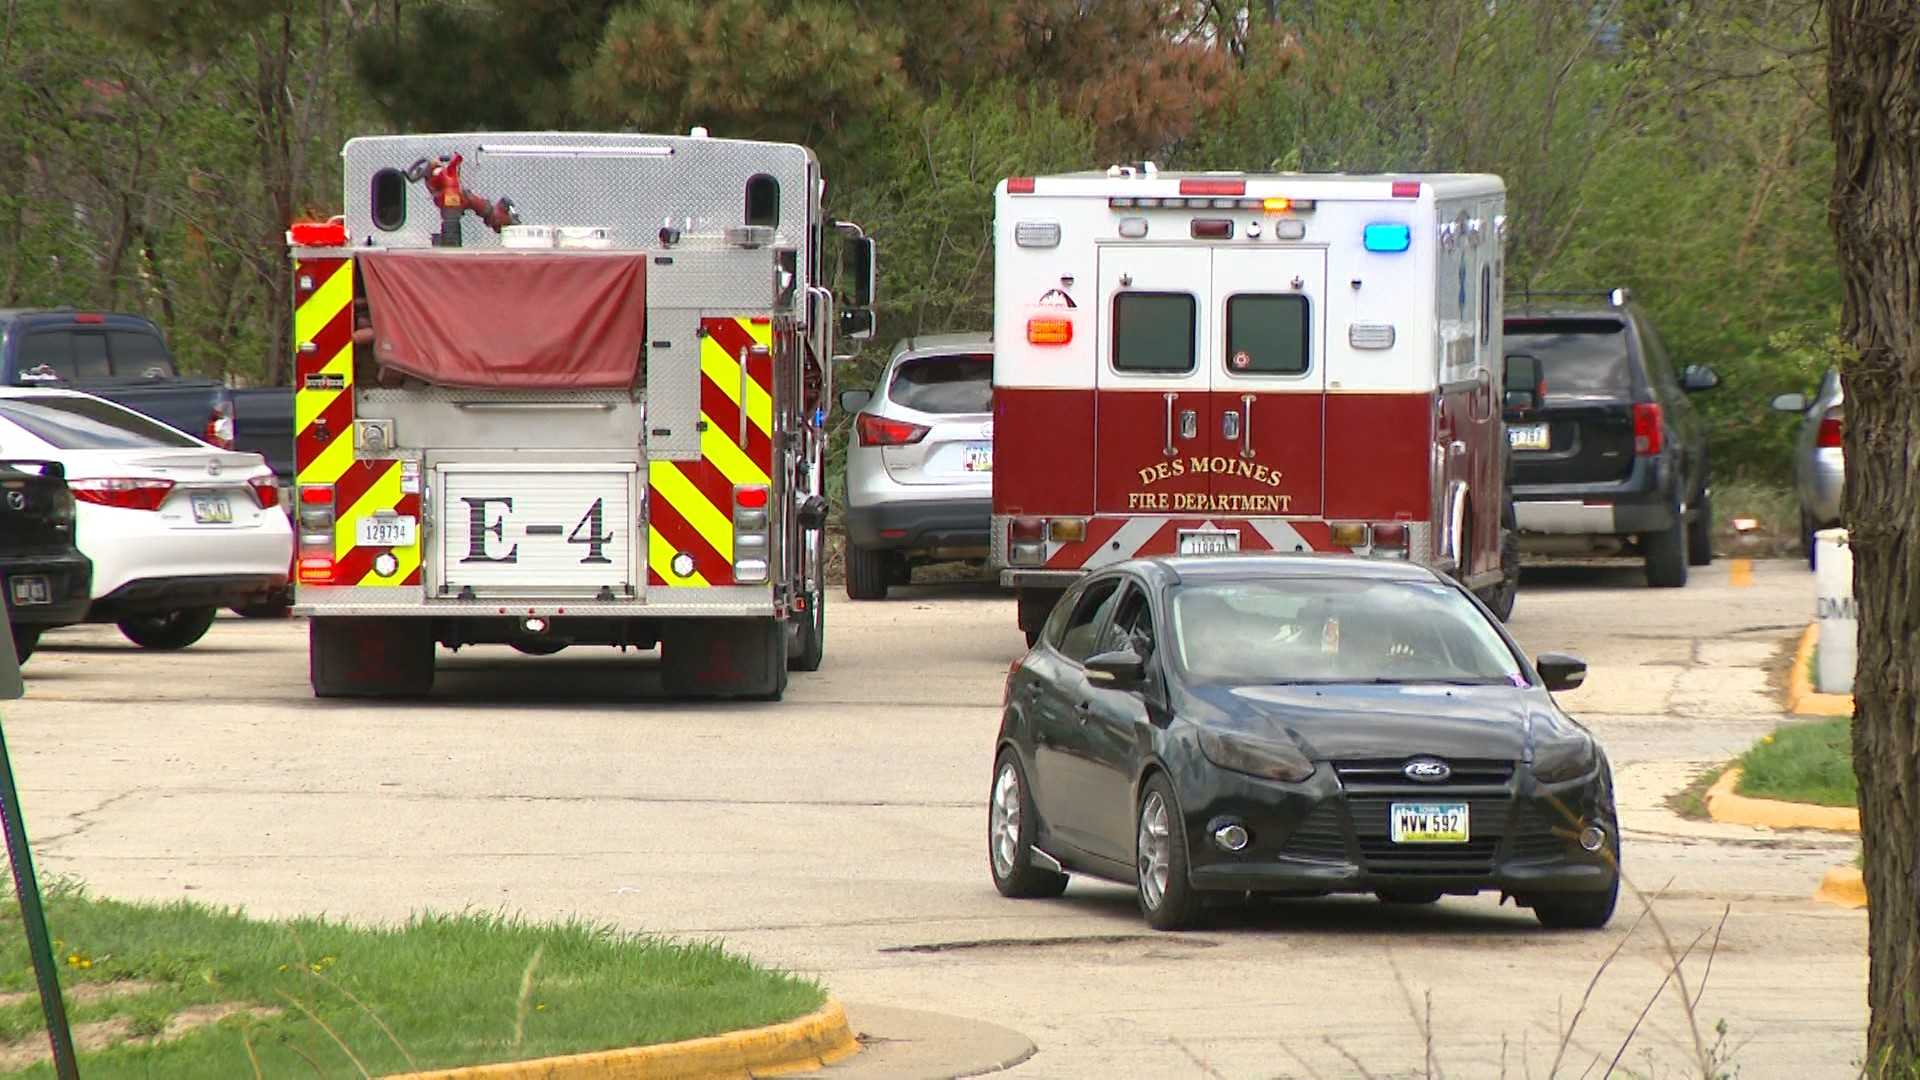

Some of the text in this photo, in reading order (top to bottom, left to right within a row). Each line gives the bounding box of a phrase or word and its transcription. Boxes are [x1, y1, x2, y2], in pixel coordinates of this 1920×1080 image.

[1138, 456, 1283, 487] DES MOINES
[1128, 492, 1292, 512] FIRE DEPARTMENT
[366, 525, 406, 540] 129734
[459, 497, 614, 564] E-4
[1401, 815, 1458, 832] MVW 592
